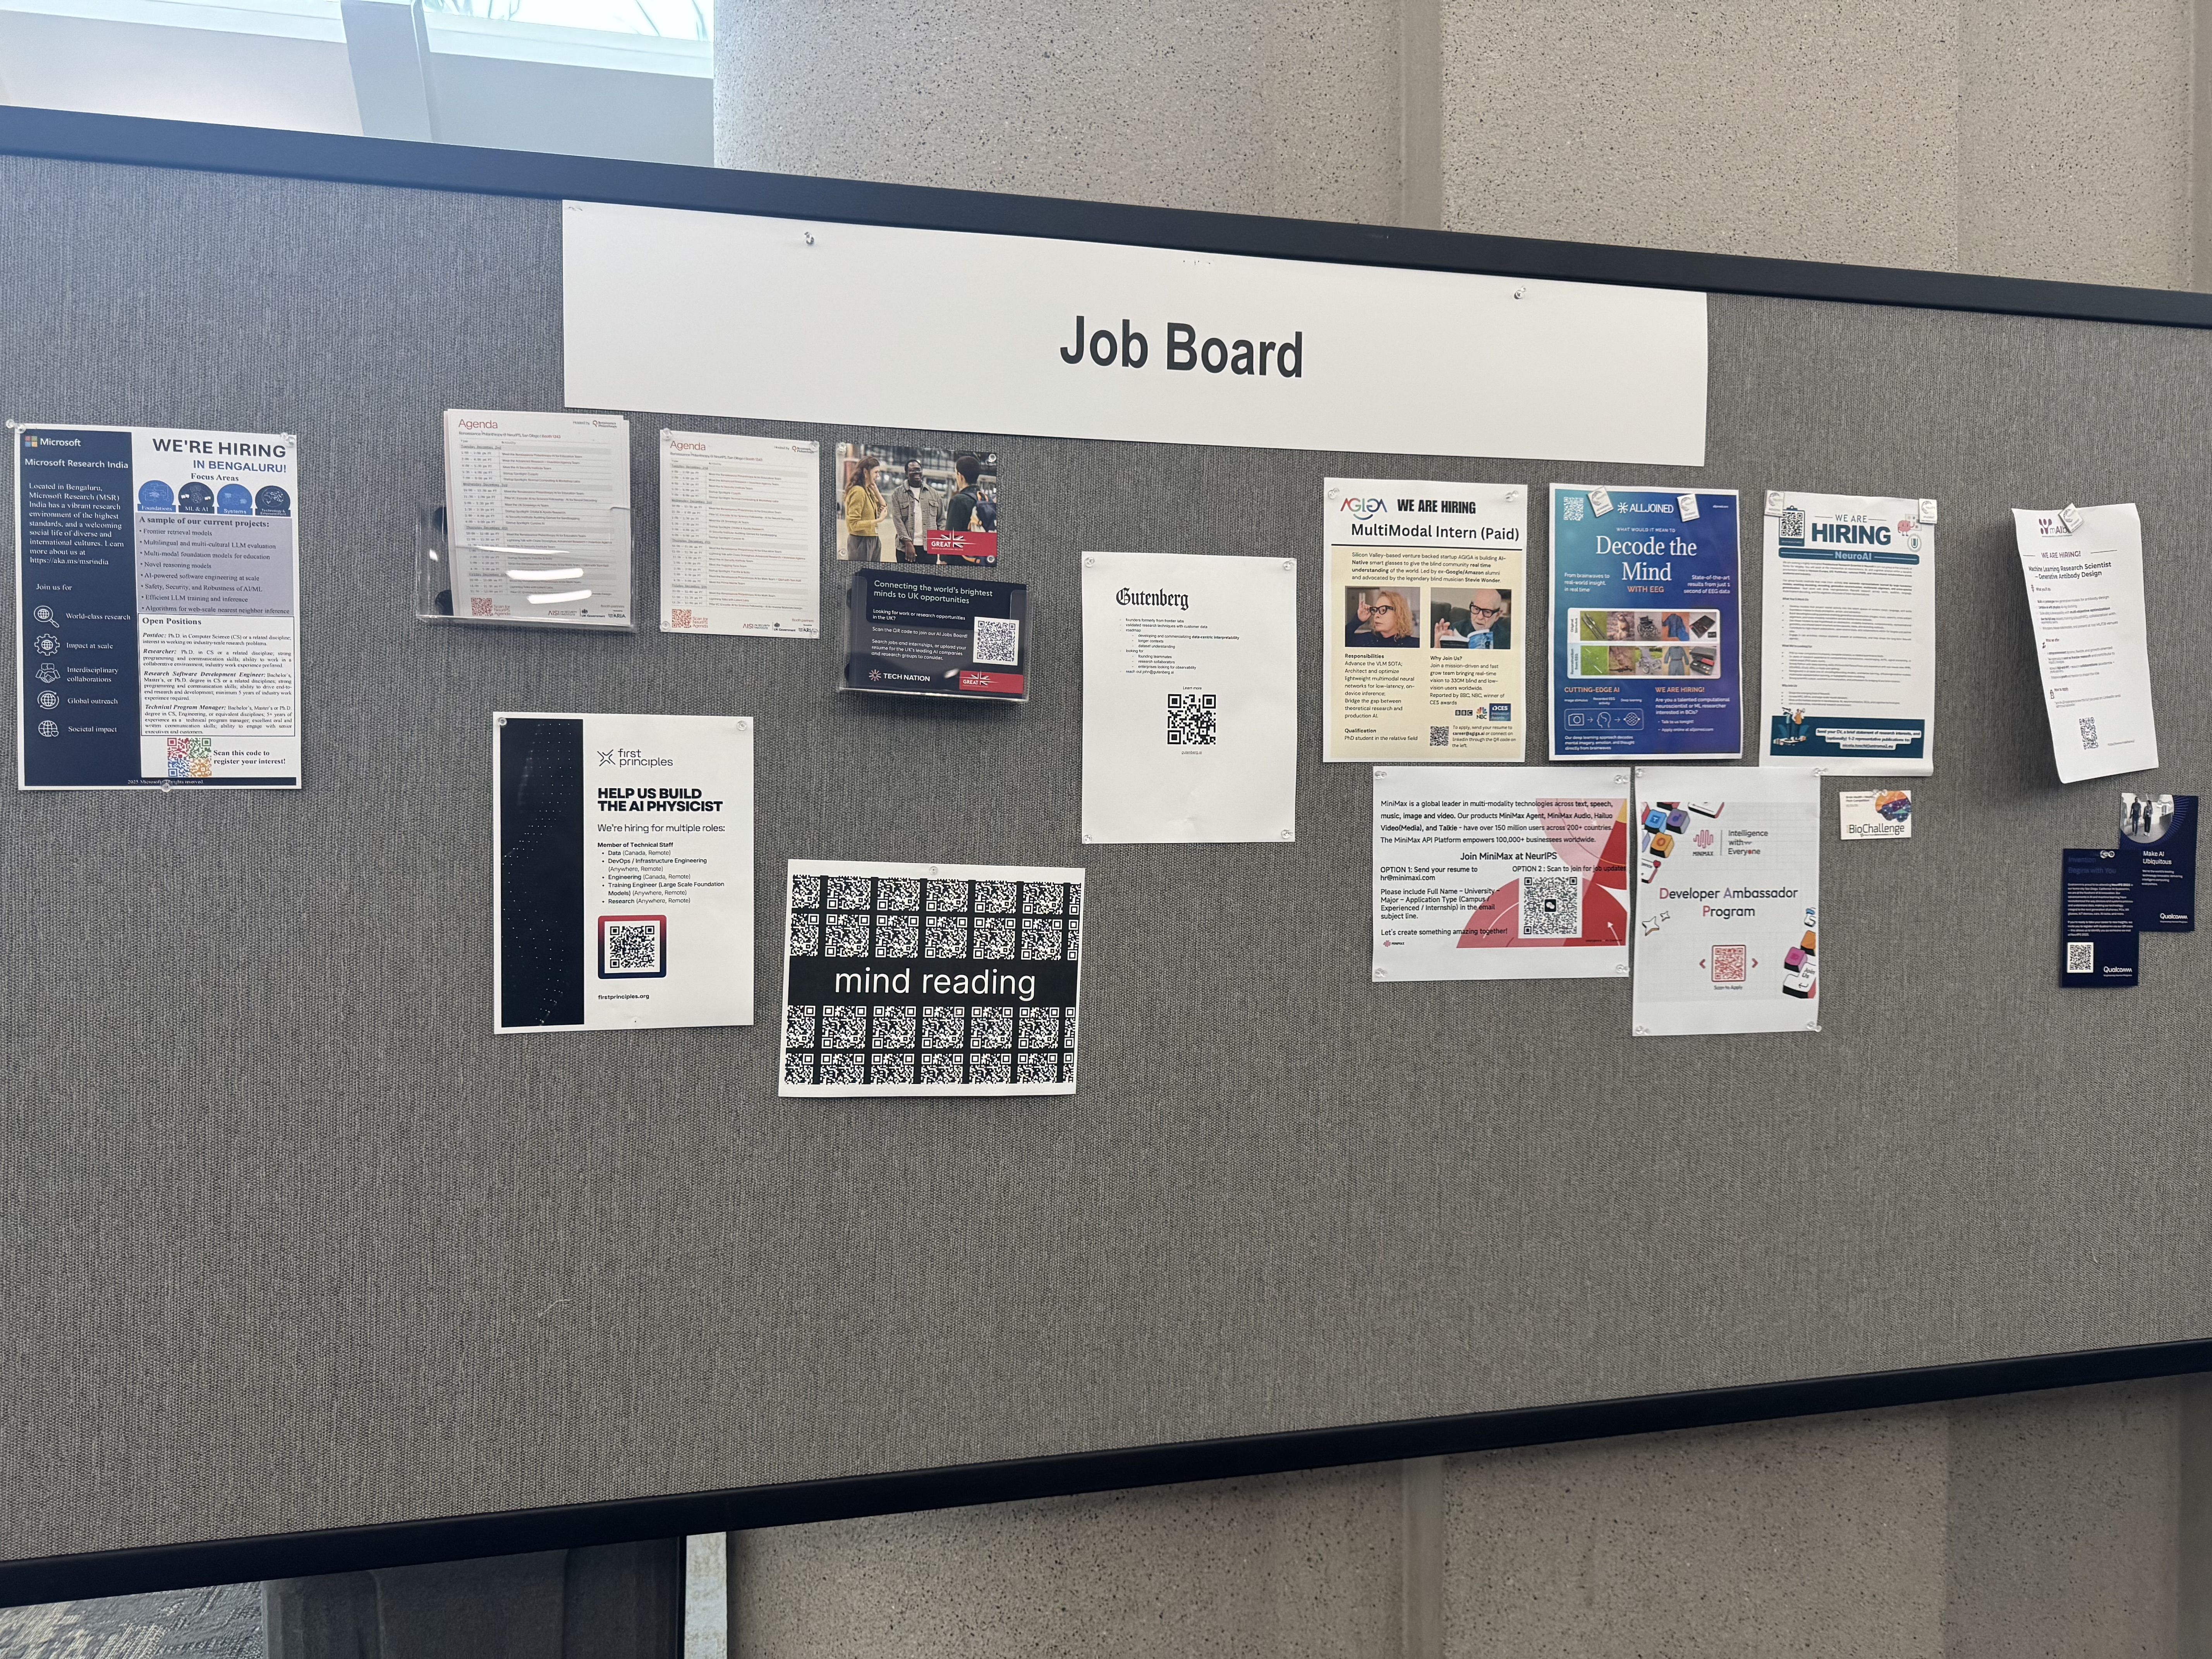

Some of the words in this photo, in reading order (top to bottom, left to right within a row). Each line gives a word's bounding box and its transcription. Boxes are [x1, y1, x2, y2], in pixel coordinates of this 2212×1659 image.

[1060, 316, 1148, 369] Job
[1167, 322, 1302, 378] Board
[458, 419, 498, 430] Agenda
[40, 438, 81, 447] Microsoft
[152, 438, 213, 454] WE'RE
[219, 442, 286, 458] HIRING
[670, 440, 706, 451] Agenda
[25, 459, 65, 467] Microsoft
[68, 460, 105, 468] Research
[193, 460, 204, 469] IN
[209, 460, 286, 473] BENGALURU!
[1397, 499, 1414, 512] WE
[1418, 500, 1438, 512] ARE
[1441, 500, 1476, 514] HIRING
[1629, 503, 1674, 513] ALLJOINED
[1352, 523, 1432, 537] MultiModal
[1436, 526, 1477, 539] Intern
[1481, 527, 1519, 541] (Paid)
[1812, 523, 1891, 545] HIRING
[1596, 536, 1665, 555] Decode
[1669, 537, 1697, 556] the
[1834, 551, 1873, 561] NeuroAI
[1621, 562, 1672, 581] Mind
[2084, 562, 2112, 570] Scientist
[874, 580, 917, 591] Connecting
[960, 587, 993, 597] brightest
[921, 595, 969, 604] opportunities
[1116, 587, 1188, 611] Gutenberg
[142, 617, 163, 625] Open
[618, 748, 641, 758] first
[620, 757, 673, 768] principles
[598, 788, 635, 799] HELP
[637, 788, 656, 799] US
[659, 788, 702, 799] BUILD
[598, 800, 627, 811] THE
[629, 800, 644, 811] AI
[647, 800, 723, 812] PHYSICIST
[597, 824, 623, 832] We're
[625, 824, 649, 834] hiring
[650, 824, 664, 832] for
[666, 824, 701, 833] multiple
[1728, 830, 1769, 838] Intelligence
[1849, 823, 1905, 835] BioChallenge
[1460, 852, 1477, 860] Join
[1479, 852, 1513, 860] MiniMax
[1525, 852, 1557, 860] NeurIPS
[1728, 848, 1761, 856] Everyone
[1659, 887, 1721, 901] Developer
[1723, 887, 1798, 898] Ambassador
[1703, 905, 1755, 919] Program
[835, 967, 910, 993] mind
[923, 969, 1035, 1001] reading
